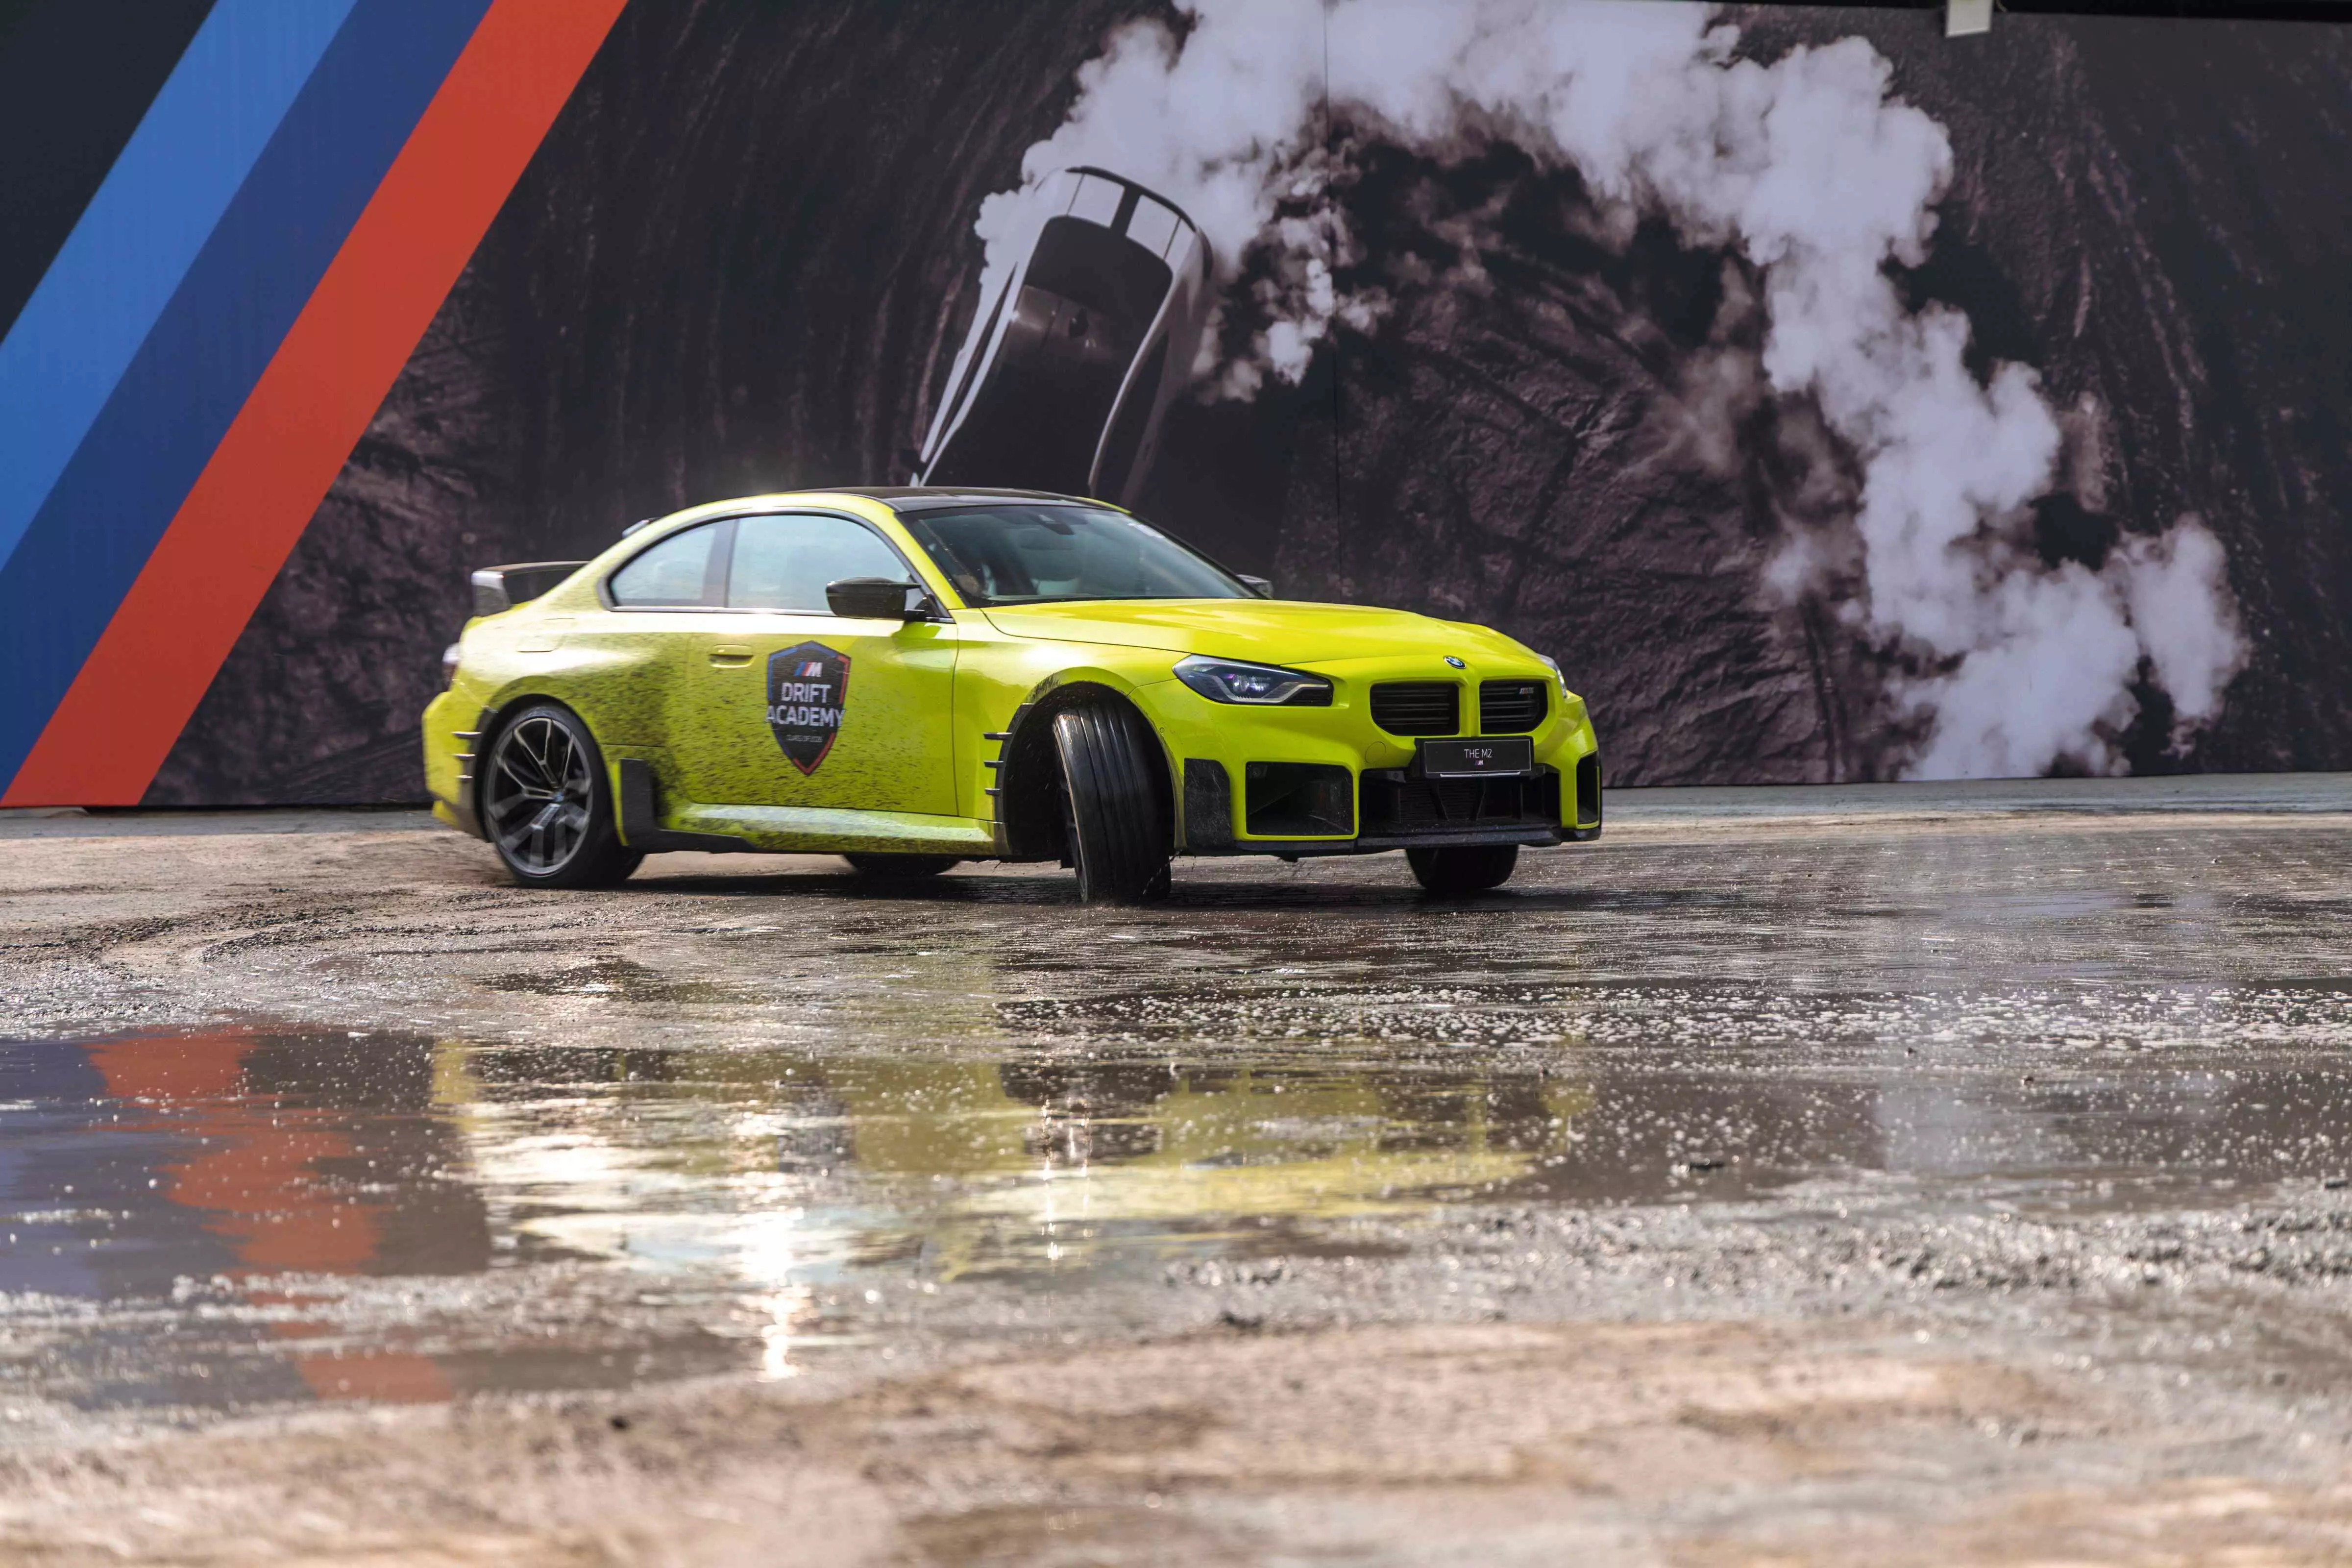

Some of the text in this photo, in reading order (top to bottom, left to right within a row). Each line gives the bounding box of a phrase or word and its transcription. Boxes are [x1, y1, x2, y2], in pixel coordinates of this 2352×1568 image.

[781, 682, 832, 703] DRIFT
[765, 705, 846, 727] ACADEMY
[1464, 748, 1492, 759] THE M2
